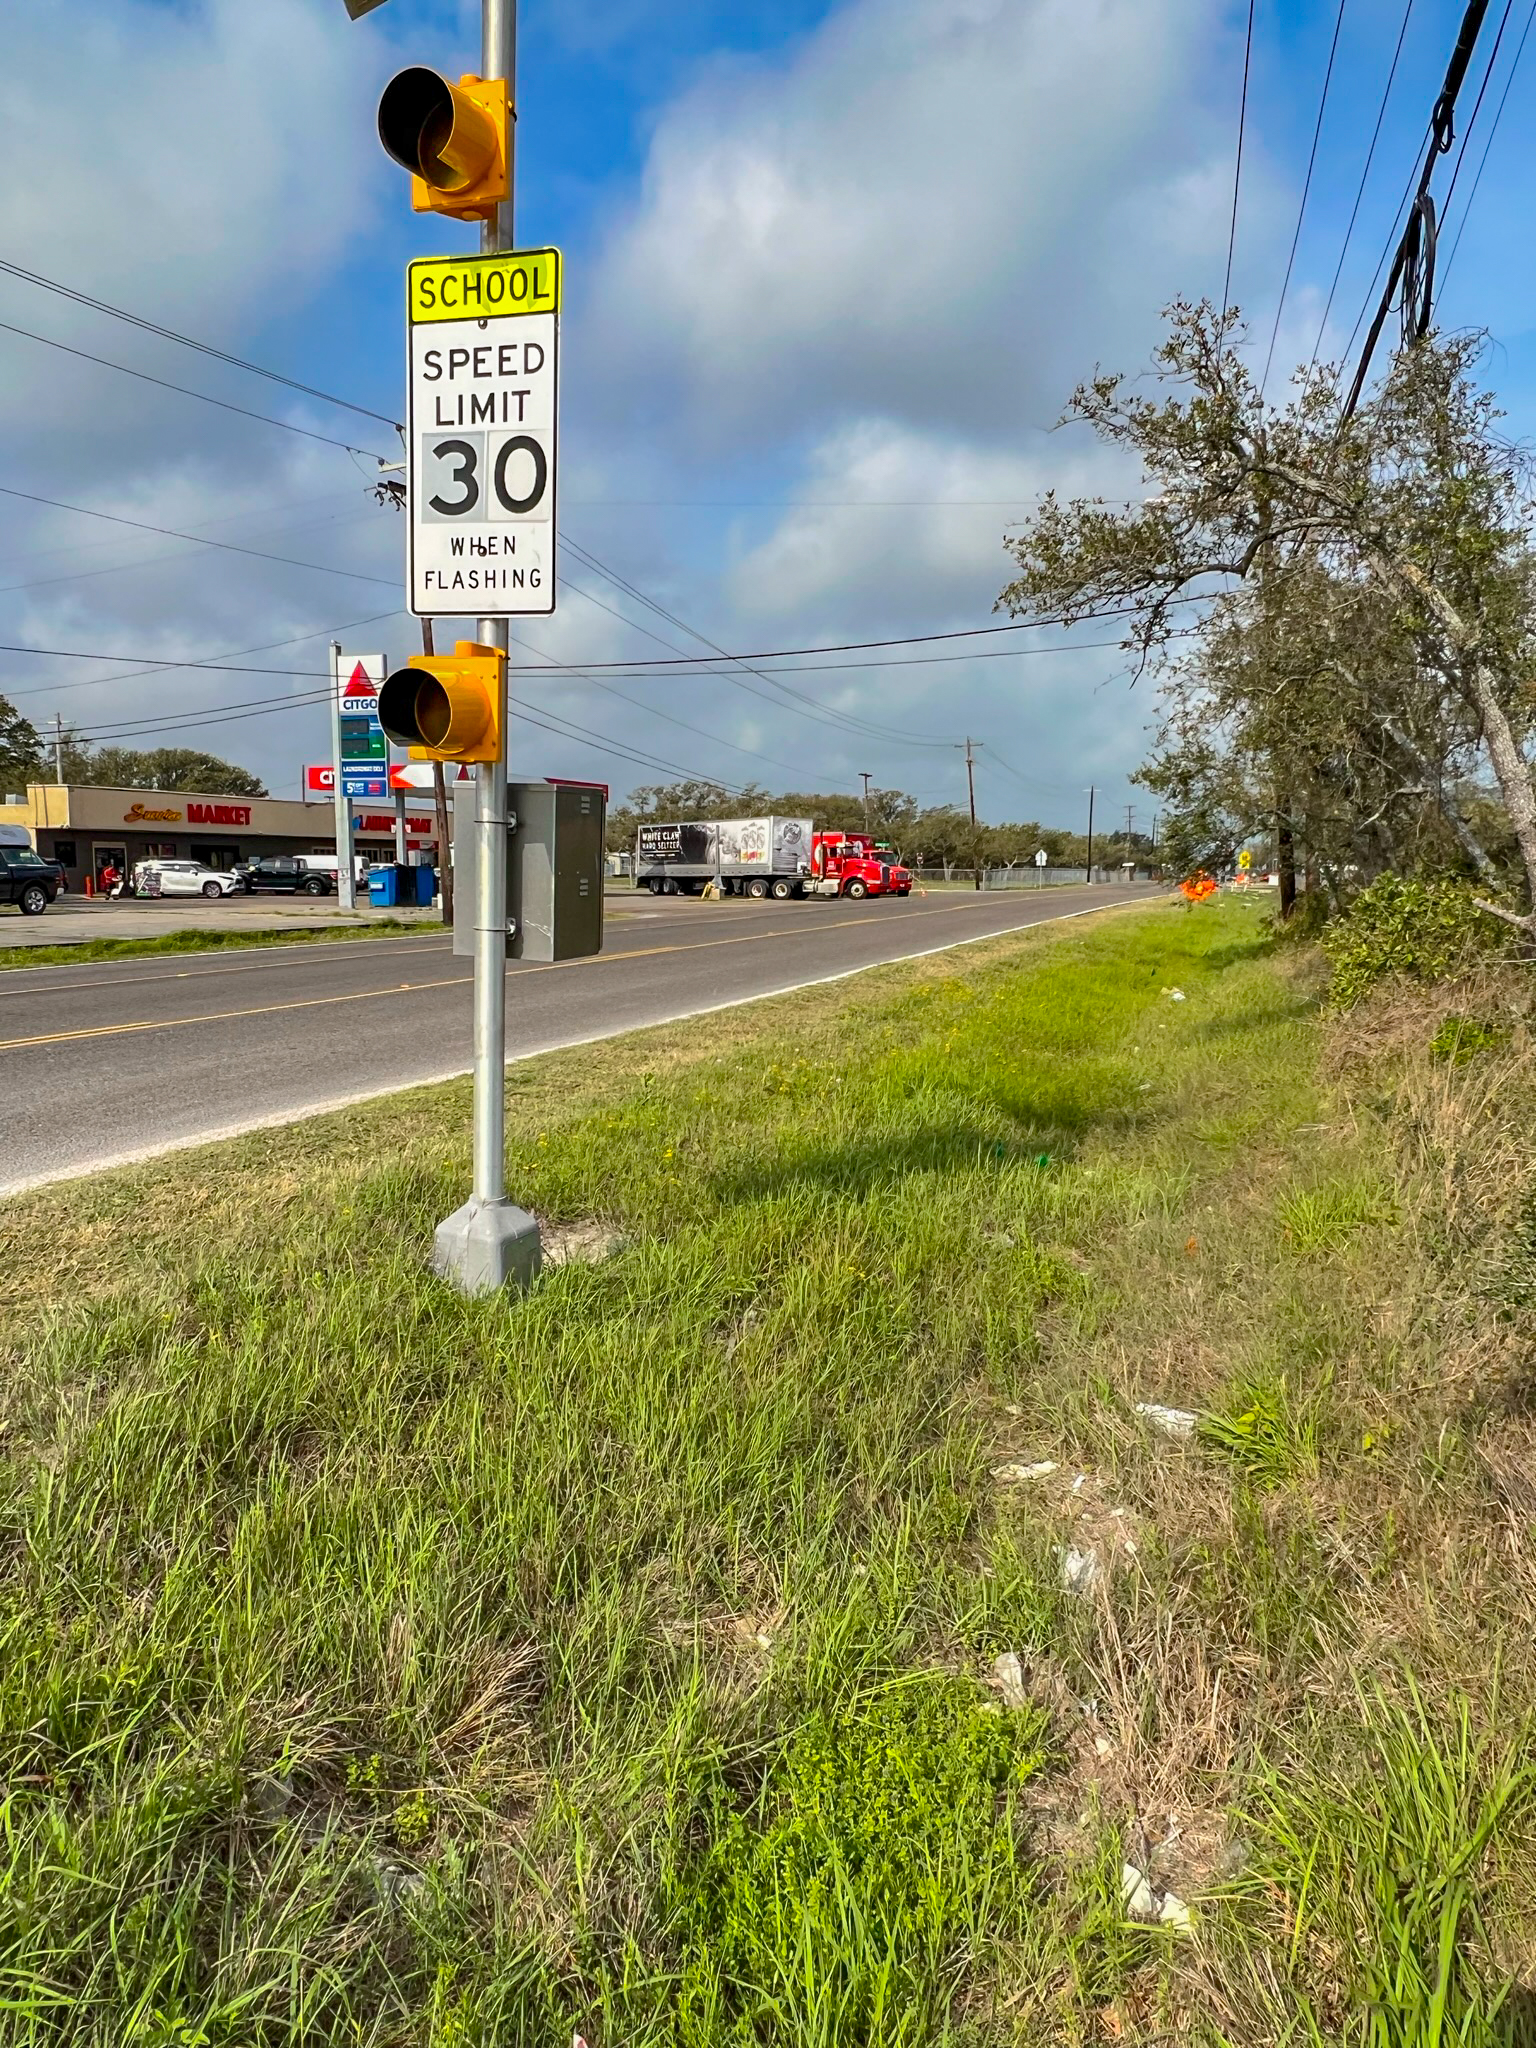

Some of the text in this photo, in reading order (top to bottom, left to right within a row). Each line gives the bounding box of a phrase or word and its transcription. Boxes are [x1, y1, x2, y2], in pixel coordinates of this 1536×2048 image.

[419, 266, 550, 309] SCHOOL
[423, 343, 545, 381] SPEED
[435, 390, 531, 426] LIMIT
[428, 435, 547, 516] 30
[450, 535, 516, 557] WHEN
[425, 568, 542, 590] FLASHING
[343, 698, 378, 710] CITGO
[187, 803, 252, 825] MARKET
[642, 831, 680, 841] WHITE CLAW
